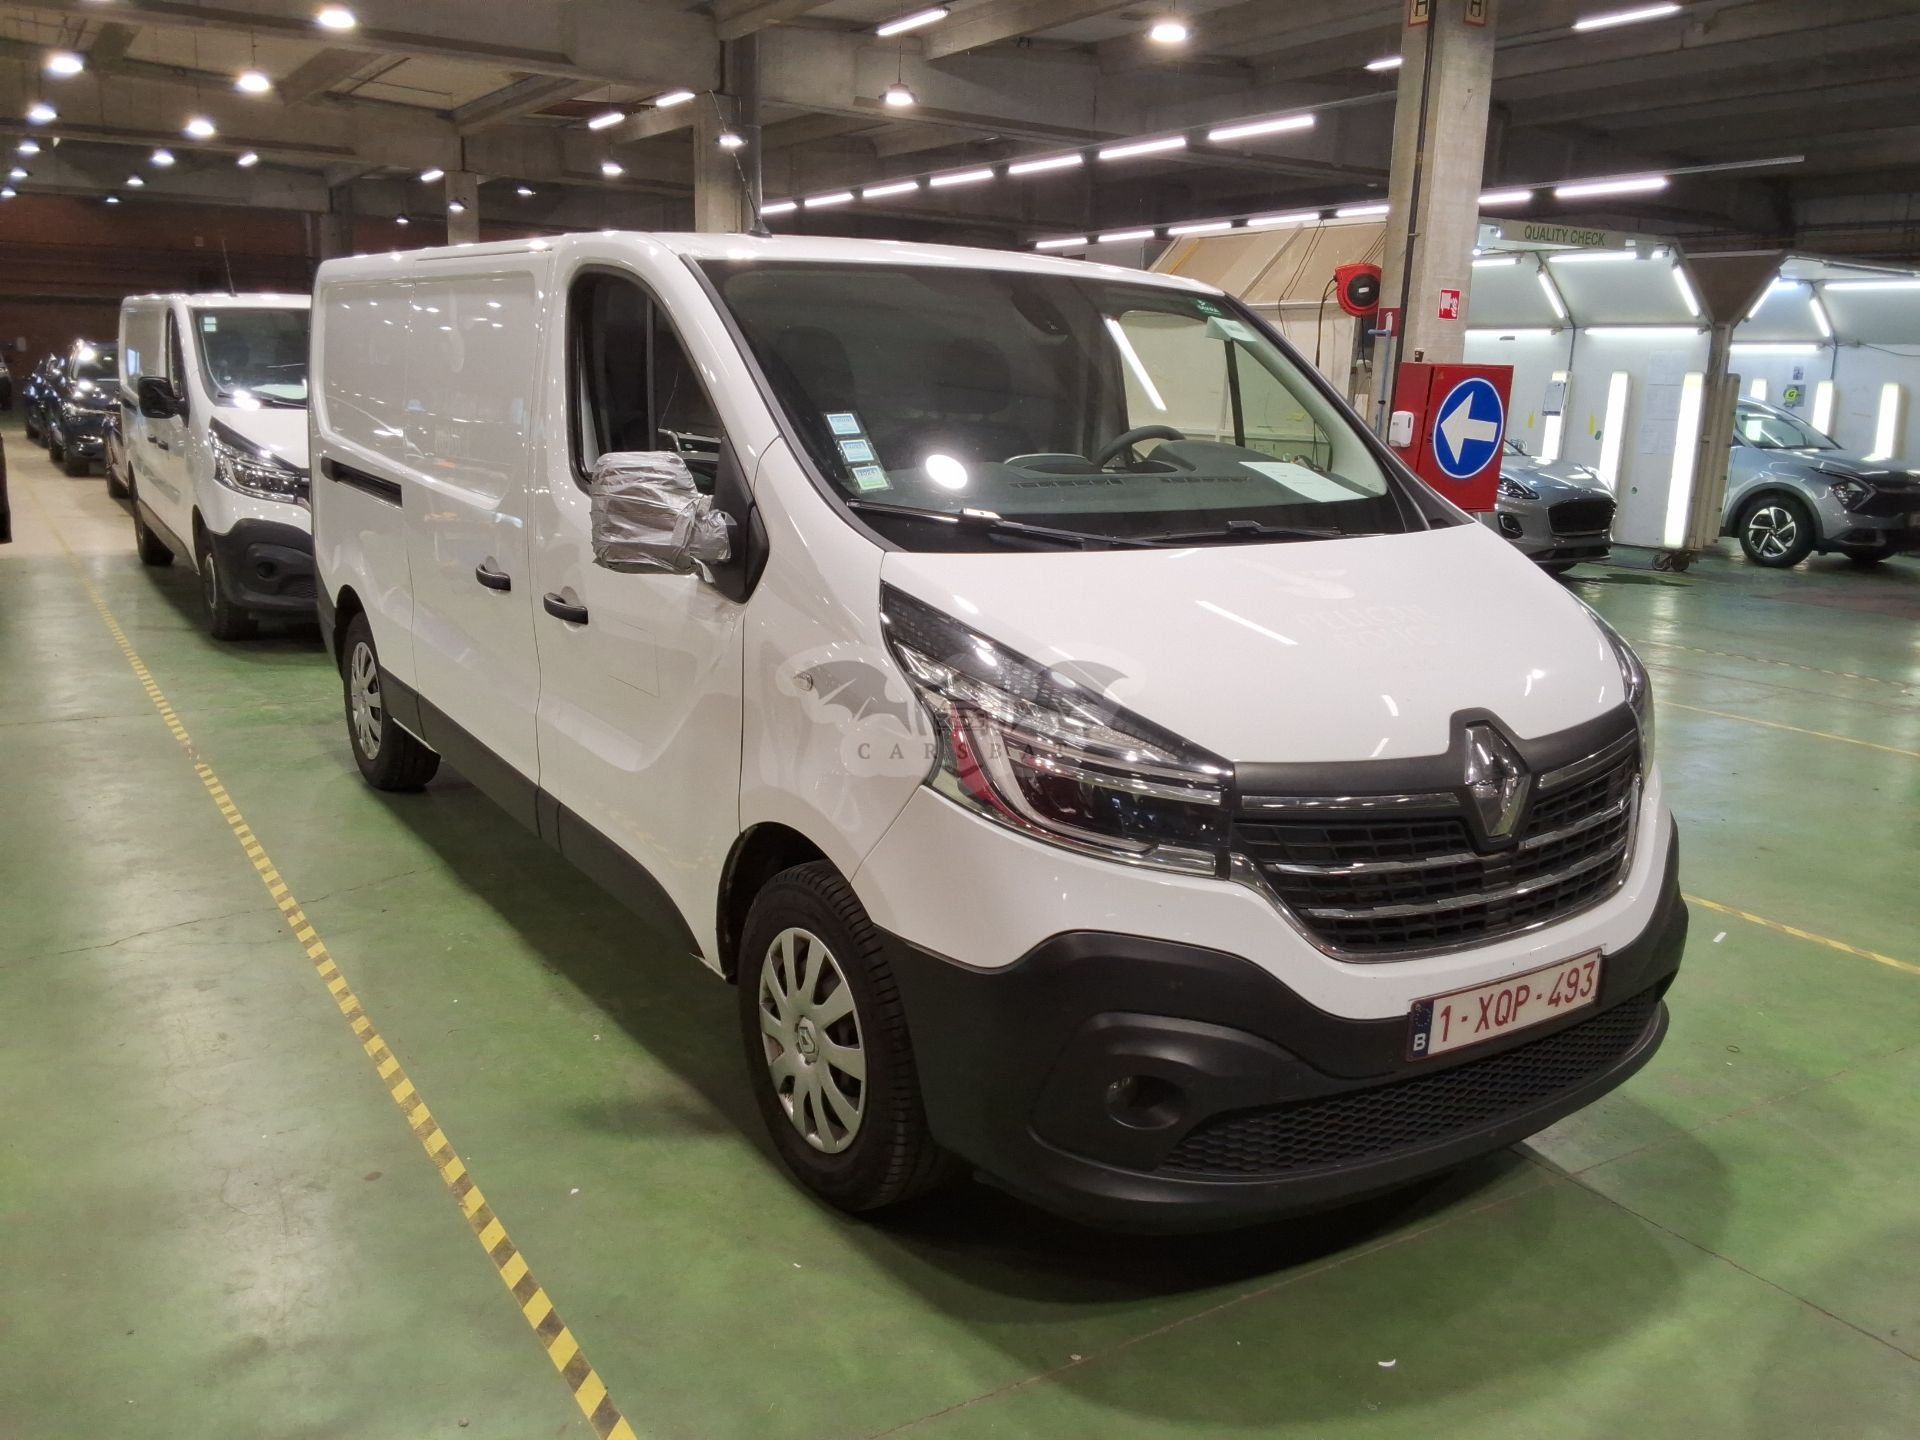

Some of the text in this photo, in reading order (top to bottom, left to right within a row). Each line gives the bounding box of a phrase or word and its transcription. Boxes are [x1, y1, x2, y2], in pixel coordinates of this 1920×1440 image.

[1524, 225, 1606, 246] QUALITY CHECK
[1413, 1033, 1426, 1051] B
